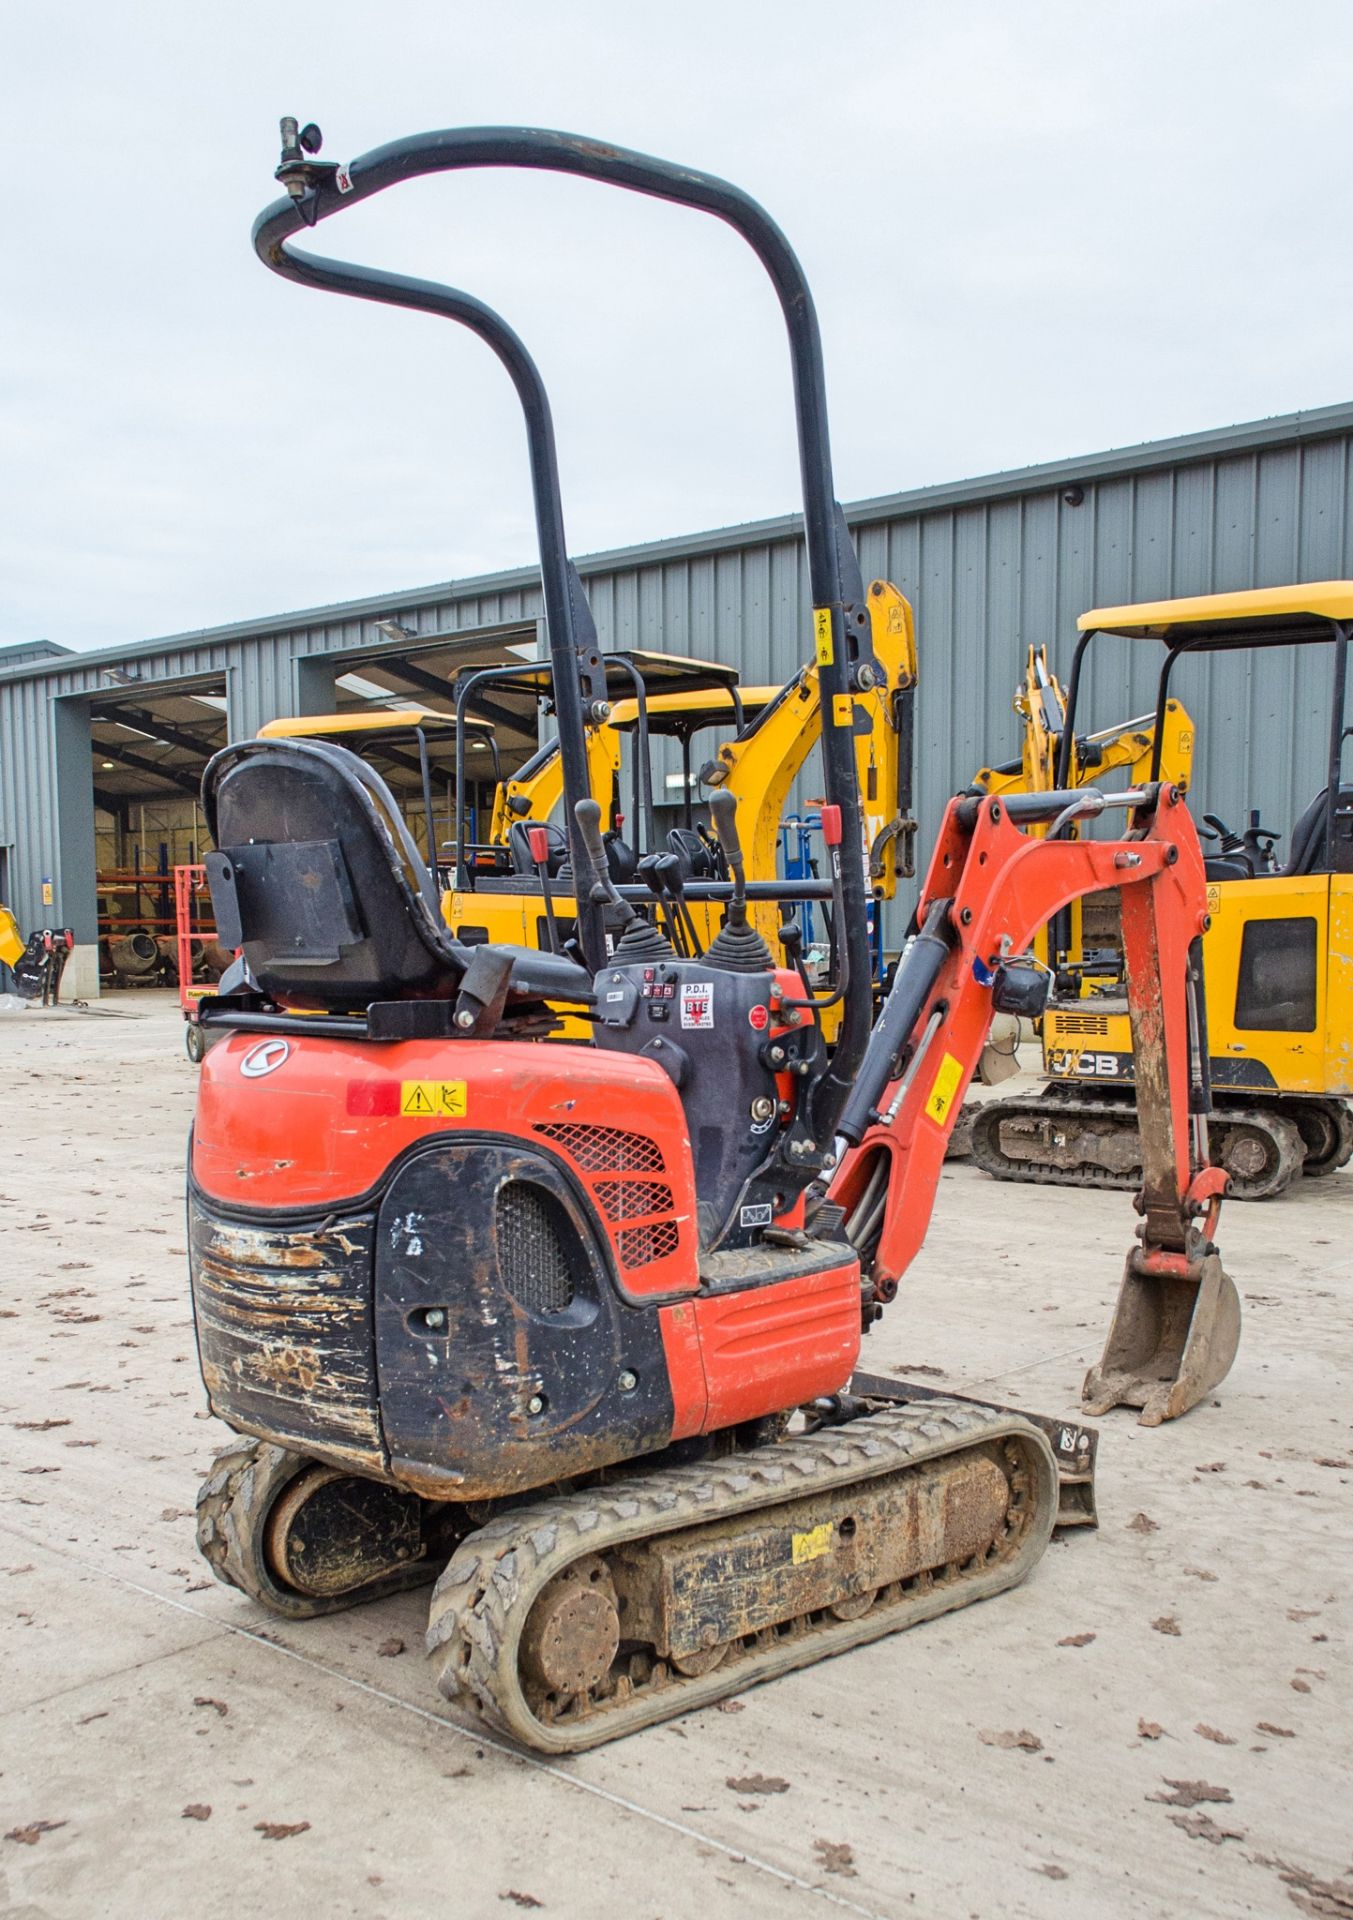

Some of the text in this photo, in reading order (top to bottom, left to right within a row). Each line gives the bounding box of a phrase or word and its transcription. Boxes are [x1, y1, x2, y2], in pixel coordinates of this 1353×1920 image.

[686, 985, 708, 993] P.D.I.
[685, 1001, 708, 1014] BTE
[1053, 1053, 1119, 1075] JCB
